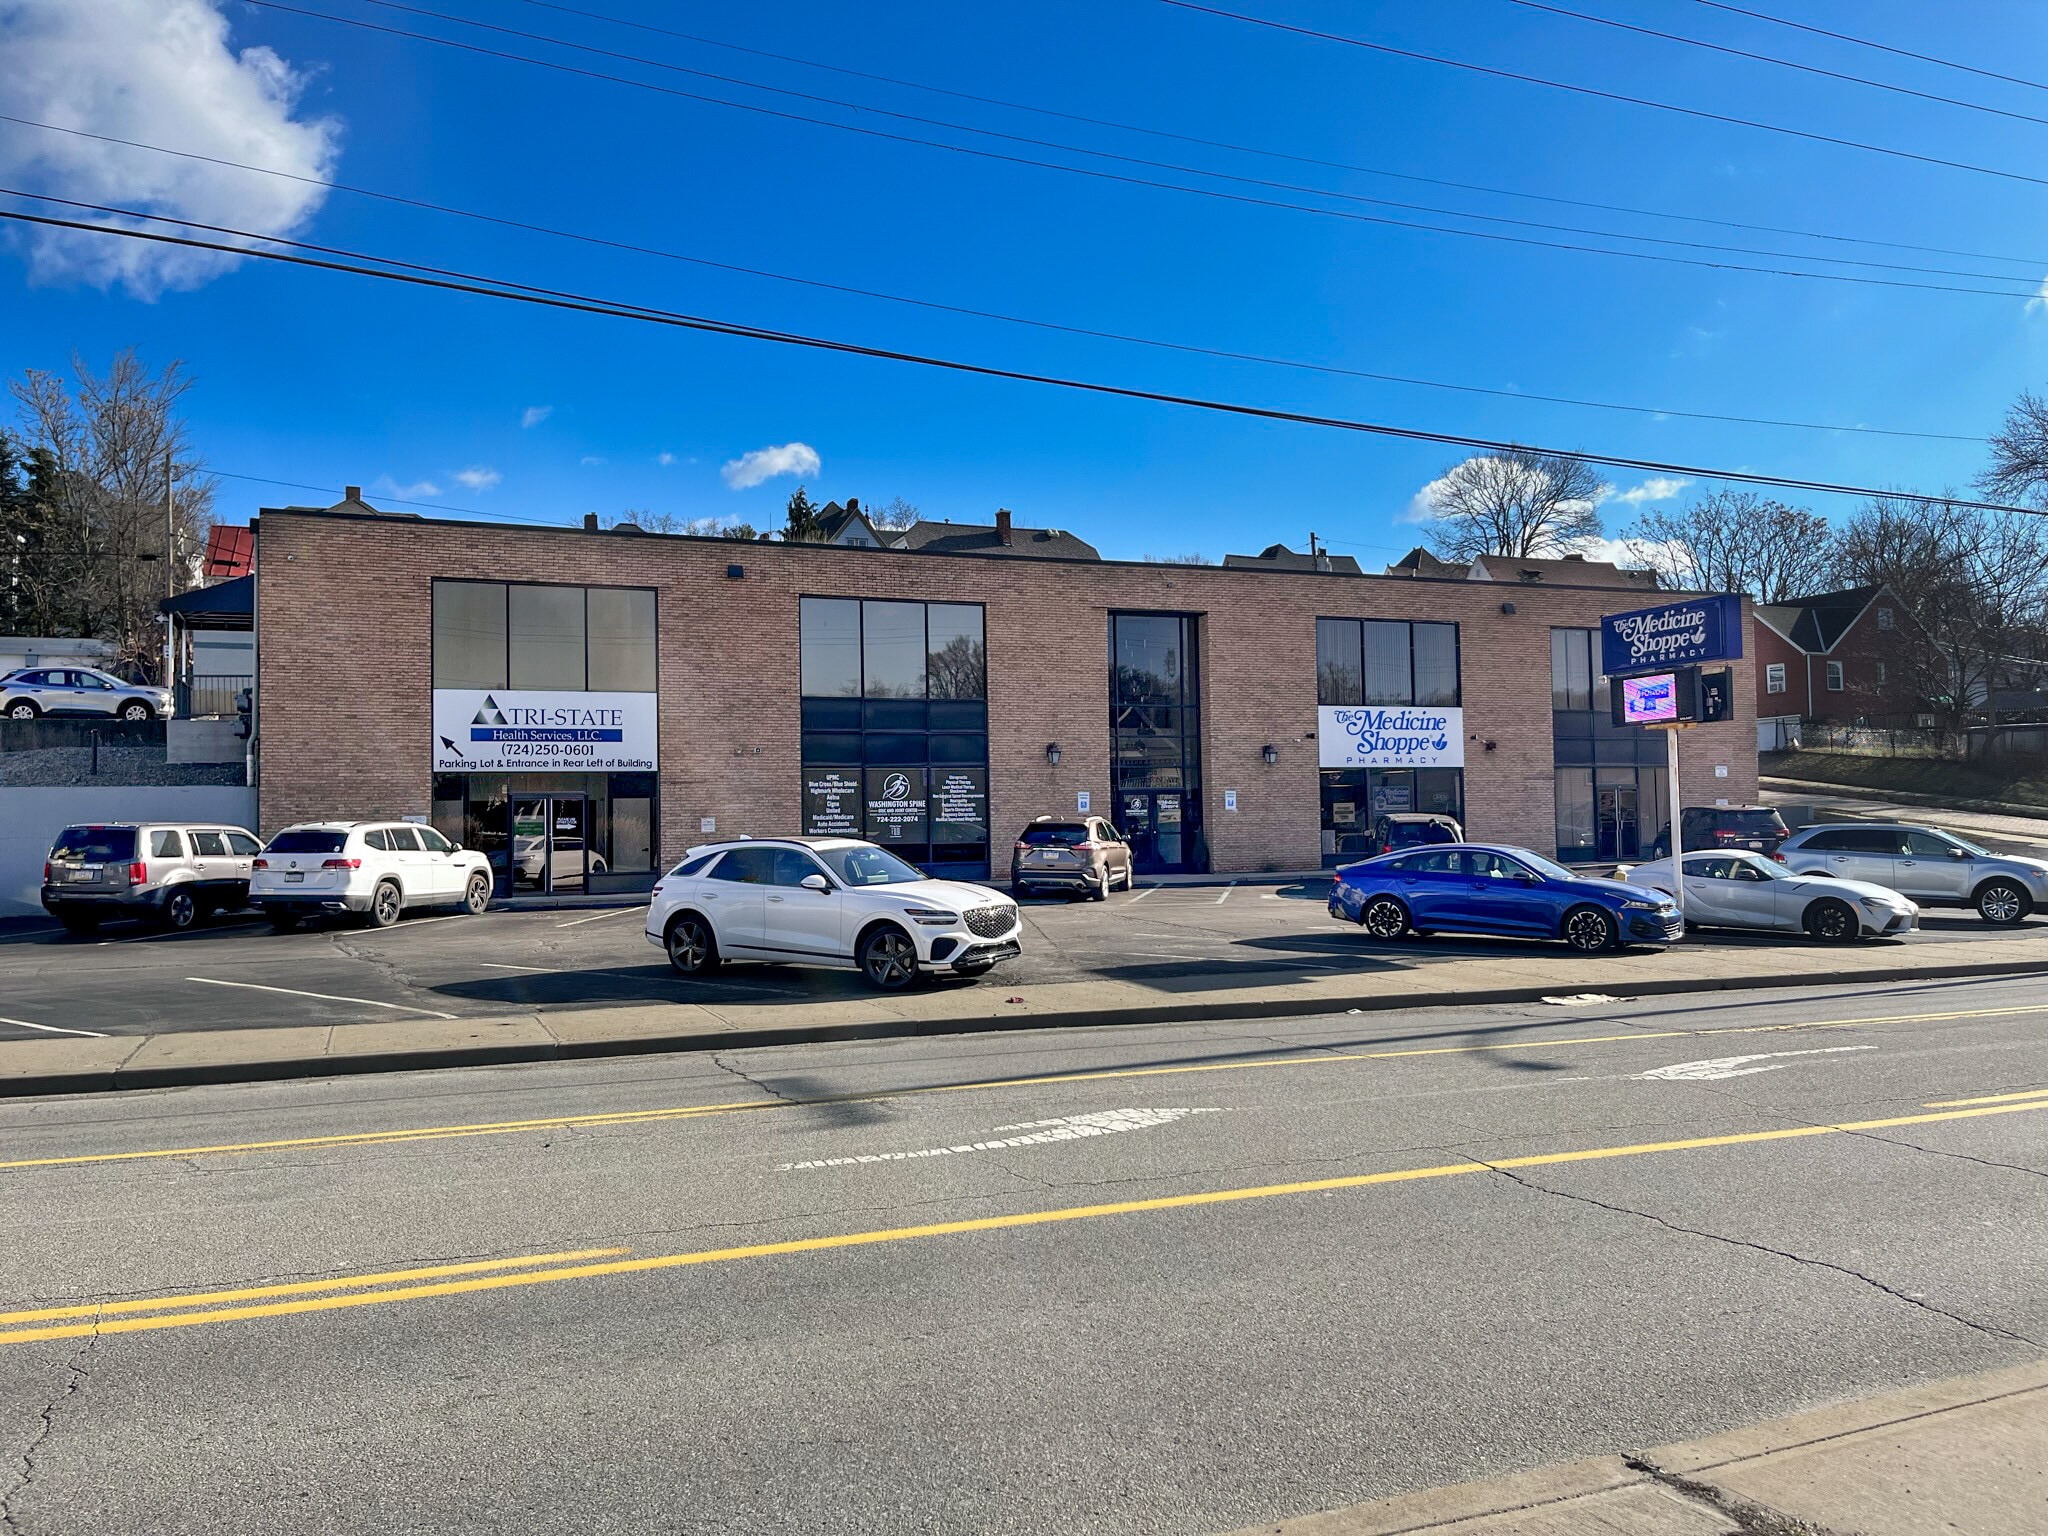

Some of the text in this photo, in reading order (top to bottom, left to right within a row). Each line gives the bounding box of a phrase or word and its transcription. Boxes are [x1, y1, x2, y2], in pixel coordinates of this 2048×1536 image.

[1614, 608, 1706, 641] The Medicine
[1631, 634, 1689, 656] Shoppe
[1631, 648, 1706, 664] PHARMACY
[509, 708, 623, 726] TRI-STATE
[1334, 710, 1446, 735] The Medicine
[493, 730, 602, 741] Health Services, LLC.
[1357, 730, 1430, 755] Shoppe
[501, 743, 594, 757] (724)250-0601
[439, 759, 477, 769] Parking
[480, 760, 494, 768] Lot
[507, 760, 549, 768] Entrance
[552, 759, 560, 768] in
[563, 760, 584, 768] Rear
[587, 759, 603, 768] Left
[606, 759, 615, 768] of
[618, 759, 653, 769] Building
